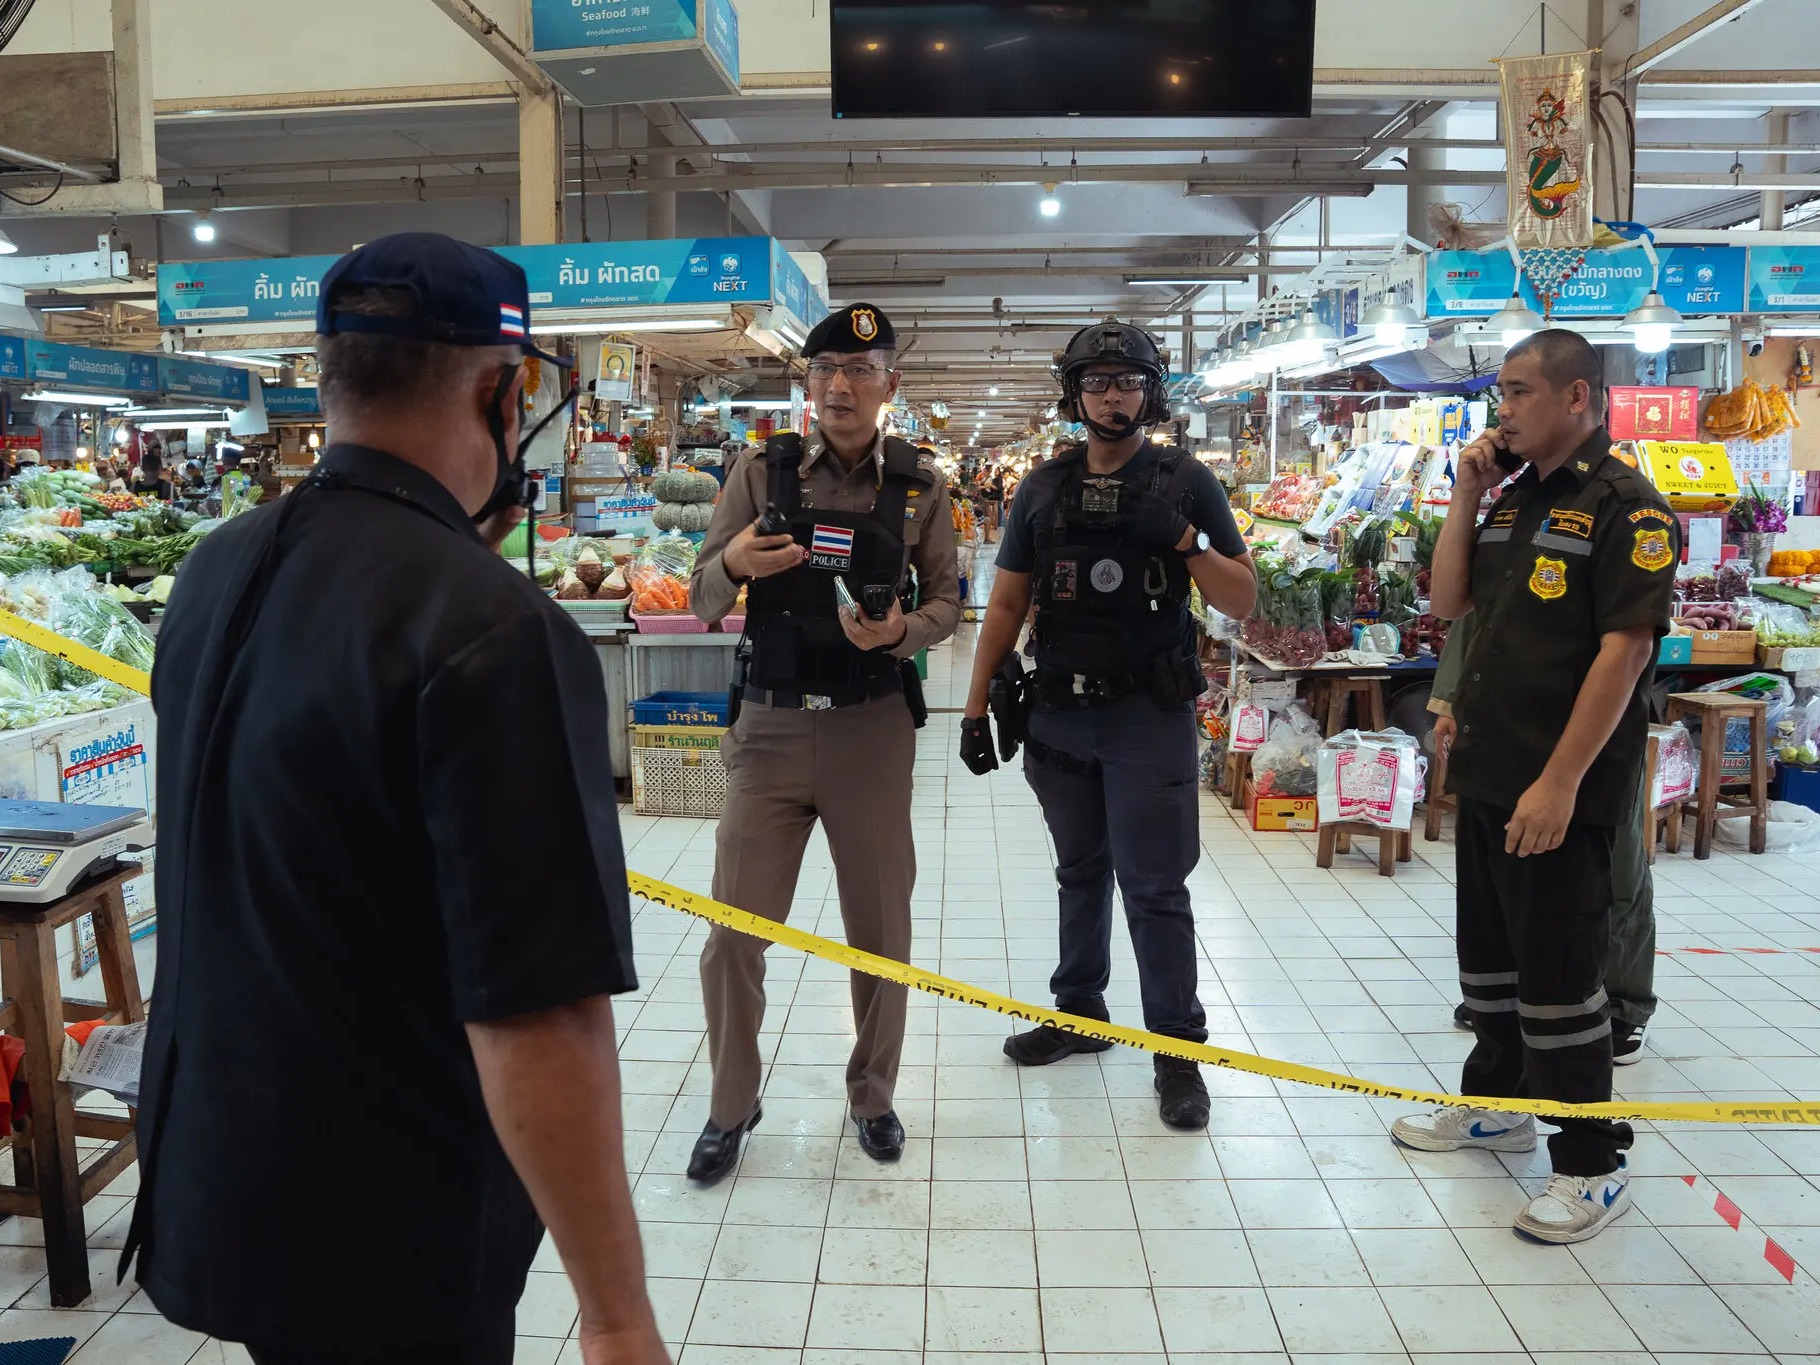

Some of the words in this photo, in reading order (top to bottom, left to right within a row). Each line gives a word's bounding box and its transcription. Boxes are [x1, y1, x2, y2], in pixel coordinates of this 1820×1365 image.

[582, 8, 626, 21] Seafood
[598, 261, 660, 283] ผักสด
[713, 281, 748, 292] NEXT
[1561, 282, 1607, 299] (ขวัญ)
[1686, 292, 1720, 303] NEXT
[68, 357, 126, 376] ผักปลอดสารพิษ
[1660, 445, 1679, 454] WO
[1631, 510, 1671, 524] RESCUE
[812, 555, 849, 568] POLICE
